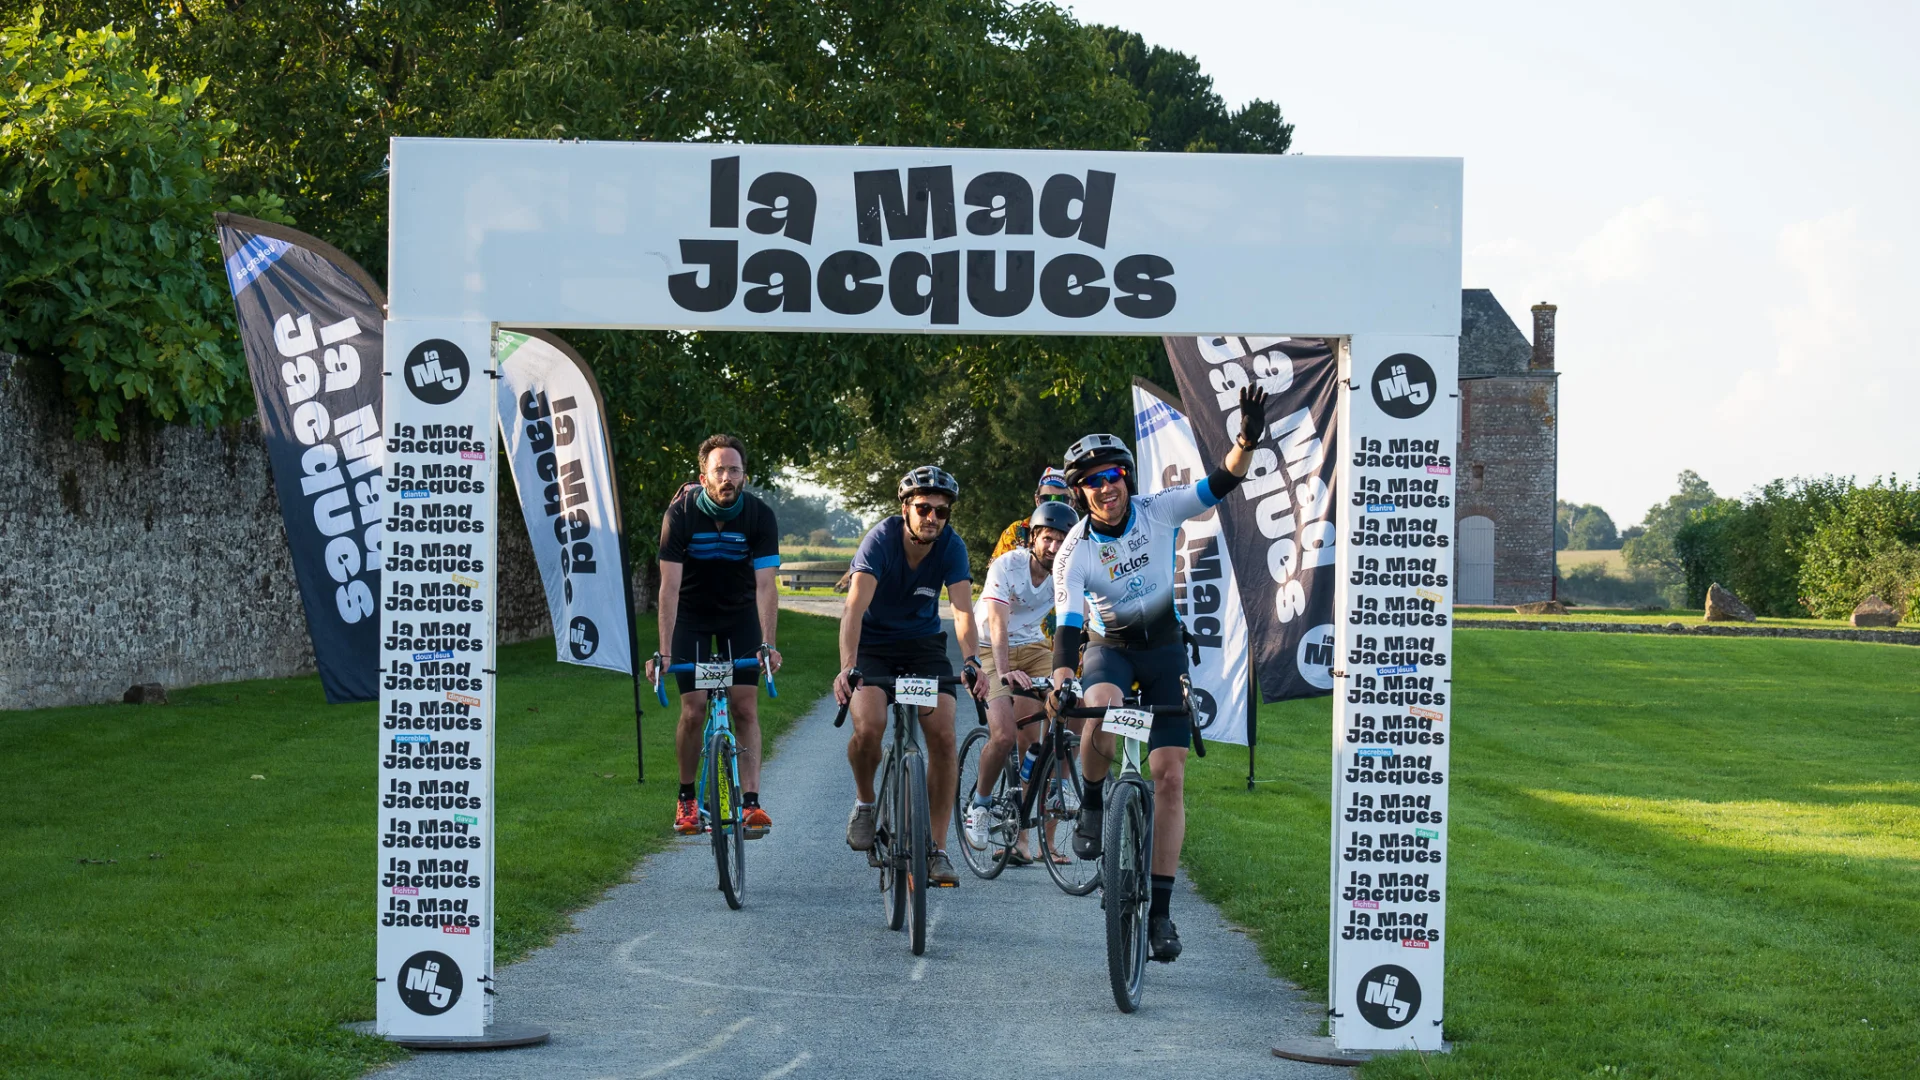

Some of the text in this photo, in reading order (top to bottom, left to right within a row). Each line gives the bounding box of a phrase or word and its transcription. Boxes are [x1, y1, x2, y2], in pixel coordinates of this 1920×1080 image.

[710, 155, 1117, 250] la Mad
[236, 244, 275, 280] sacrebleu
[667, 238, 1178, 325] Jacques
[319, 316, 362, 393] la
[424, 350, 440, 361] la
[411, 359, 463, 391] MJ
[1391, 364, 1407, 376] la
[1378, 374, 1430, 406] MJ
[394, 422, 474, 440] la Mad
[386, 439, 485, 455] Jacques
[1360, 436, 1439, 455] la Mad
[274, 312, 374, 624] Jacques
[1353, 453, 1451, 469] Jacques
[394, 462, 473, 479] la Mad
[386, 478, 485, 494] Jacques
[551, 395, 596, 574] la Mad
[1269, 406, 1336, 570] Mad
[1360, 476, 1438, 494] la Mad
[404, 490, 428, 498] diantre
[1352, 492, 1450, 509] Jacques
[393, 501, 473, 519] la Mad
[386, 518, 485, 534] Jacques
[1359, 515, 1437, 534] la Mad
[1351, 532, 1449, 548] Jacques
[393, 541, 472, 558] la Mad
[385, 557, 484, 573] Jacques
[1109, 553, 1149, 579] Kiclos
[1358, 555, 1436, 573] la Mad
[1350, 571, 1448, 587] Jacques
[392, 581, 472, 598] la Mad
[1186, 535, 1223, 649] Mad
[385, 597, 484, 613] Jacques
[1357, 594, 1436, 613] la Mad
[577, 622, 586, 631] la
[1349, 610, 1447, 627] Jacques
[392, 620, 471, 637] la Mad
[384, 636, 483, 652] Jacques
[570, 627, 593, 656] MJ
[1356, 634, 1435, 652] la Mad
[1348, 650, 1446, 666] Jacques
[392, 660, 471, 677] la Mad
[1379, 667, 1396, 675] doux
[384, 676, 483, 692] Jacques
[1355, 673, 1434, 691] la Mad
[448, 693, 479, 704] dinguerie
[902, 685, 932, 697] X426
[1347, 689, 1445, 706] Jacques
[391, 699, 470, 716] la Mad
[1411, 707, 1441, 718] dinguerie
[383, 715, 483, 731] Jacques
[1112, 714, 1144, 730] X429
[1354, 713, 1433, 731] la Mad
[1346, 729, 1444, 745] Jacques
[391, 739, 470, 756] la Mad
[383, 755, 482, 771] Jacques
[1353, 752, 1432, 770] la Mad
[1345, 768, 1443, 785] Jacques
[390, 778, 470, 795] la Mad
[383, 794, 482, 810] Jacques
[1352, 792, 1431, 810] la Mad
[1344, 808, 1442, 824] Jacques
[390, 818, 469, 835] la Mad
[382, 834, 481, 850] Jacques
[1351, 831, 1430, 849] la Mad
[1343, 847, 1441, 863] Jacques
[390, 857, 469, 874] la Mad
[382, 873, 481, 889] Jacques
[1351, 871, 1429, 889] la Mad
[1342, 887, 1440, 903] Jacques
[389, 897, 468, 914] la Mad
[381, 913, 481, 929] Jacques
[1350, 910, 1428, 928] la Mad
[453, 925, 467, 934] bim
[1341, 926, 1440, 942] Jacques
[1413, 940, 1426, 948] bim
[424, 960, 441, 973] la
[405, 966, 452, 1009] MJ
[1384, 973, 1400, 986] la
[1364, 980, 1411, 1022] MJ
